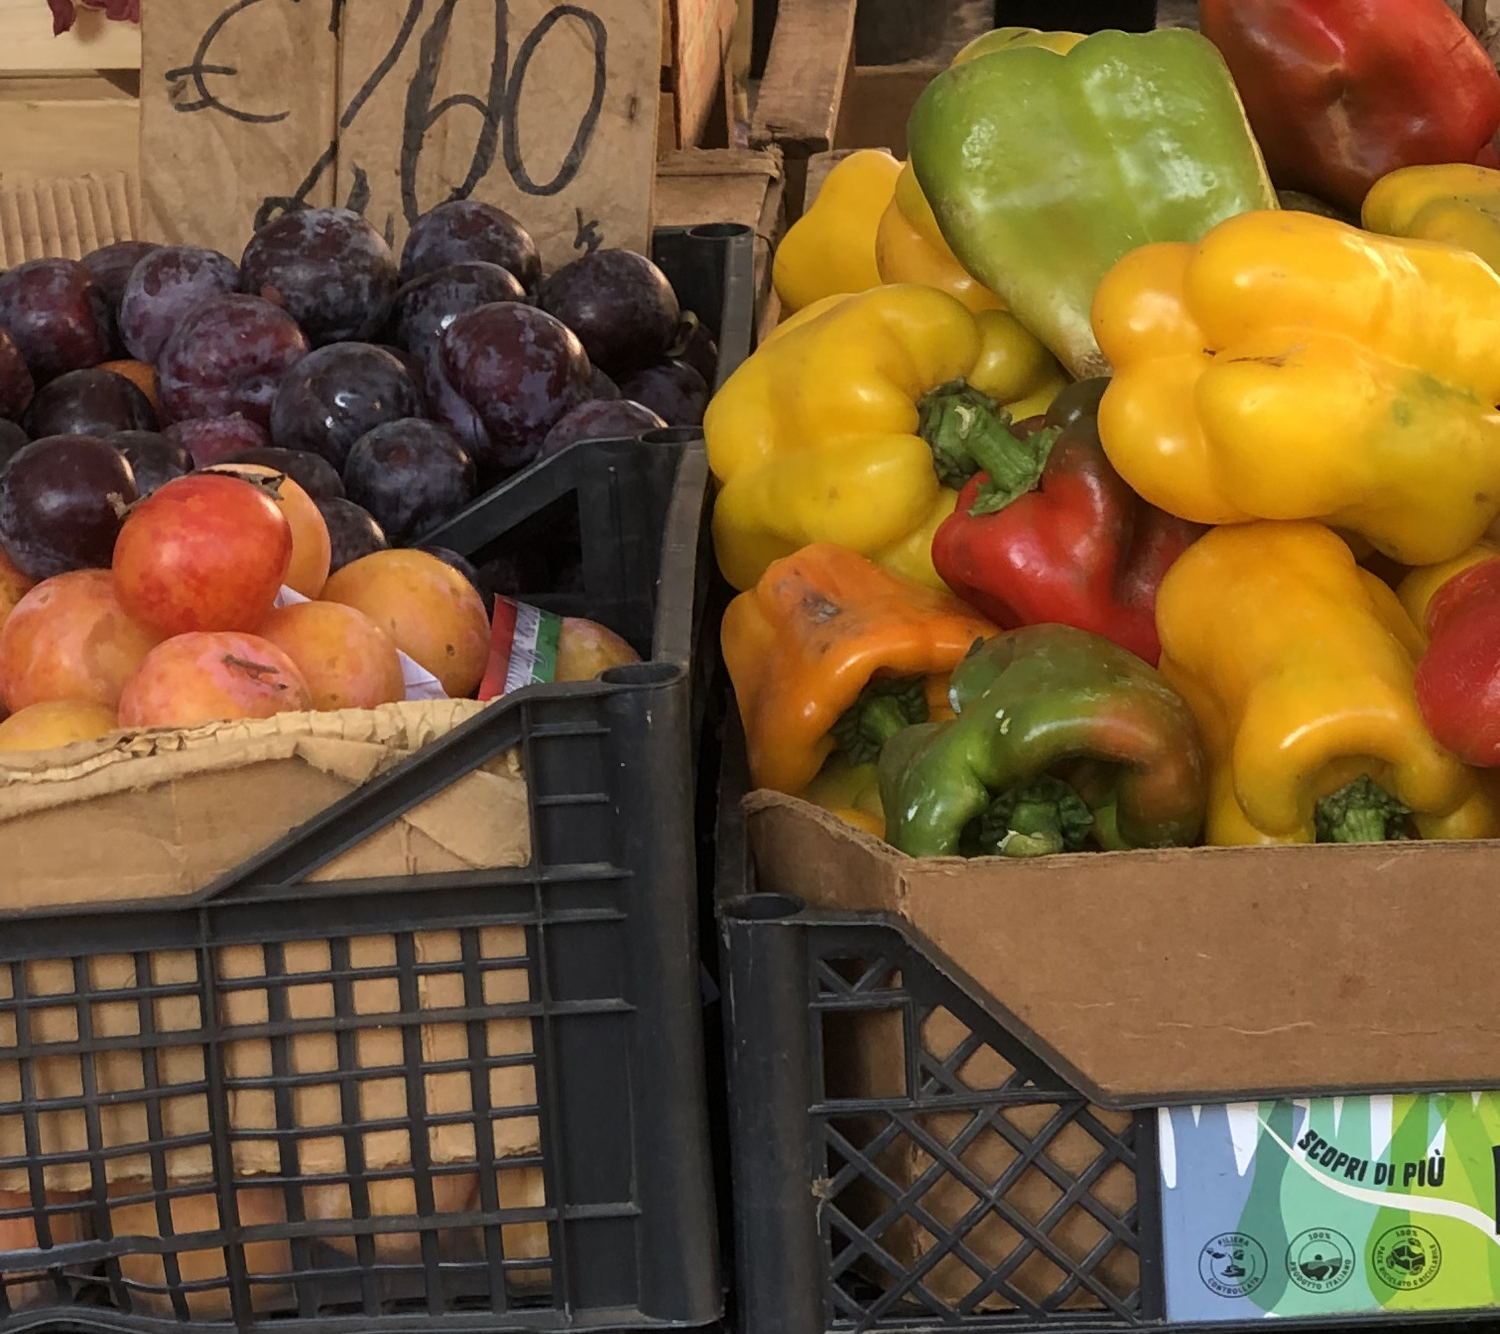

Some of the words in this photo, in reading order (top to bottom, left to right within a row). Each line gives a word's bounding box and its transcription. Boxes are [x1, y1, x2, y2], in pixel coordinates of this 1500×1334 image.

[1297, 1129, 1368, 1183] SCOPRI
[1374, 1163, 1396, 1187] DI
[1403, 1149, 1446, 1187] PIÙ
[1217, 1236, 1250, 1248] FILIERA
[1308, 1231, 1332, 1241] 100%
[1325, 1258, 1352, 1289] ITALIANO
[1207, 1276, 1260, 1294] CONTROLLATA
